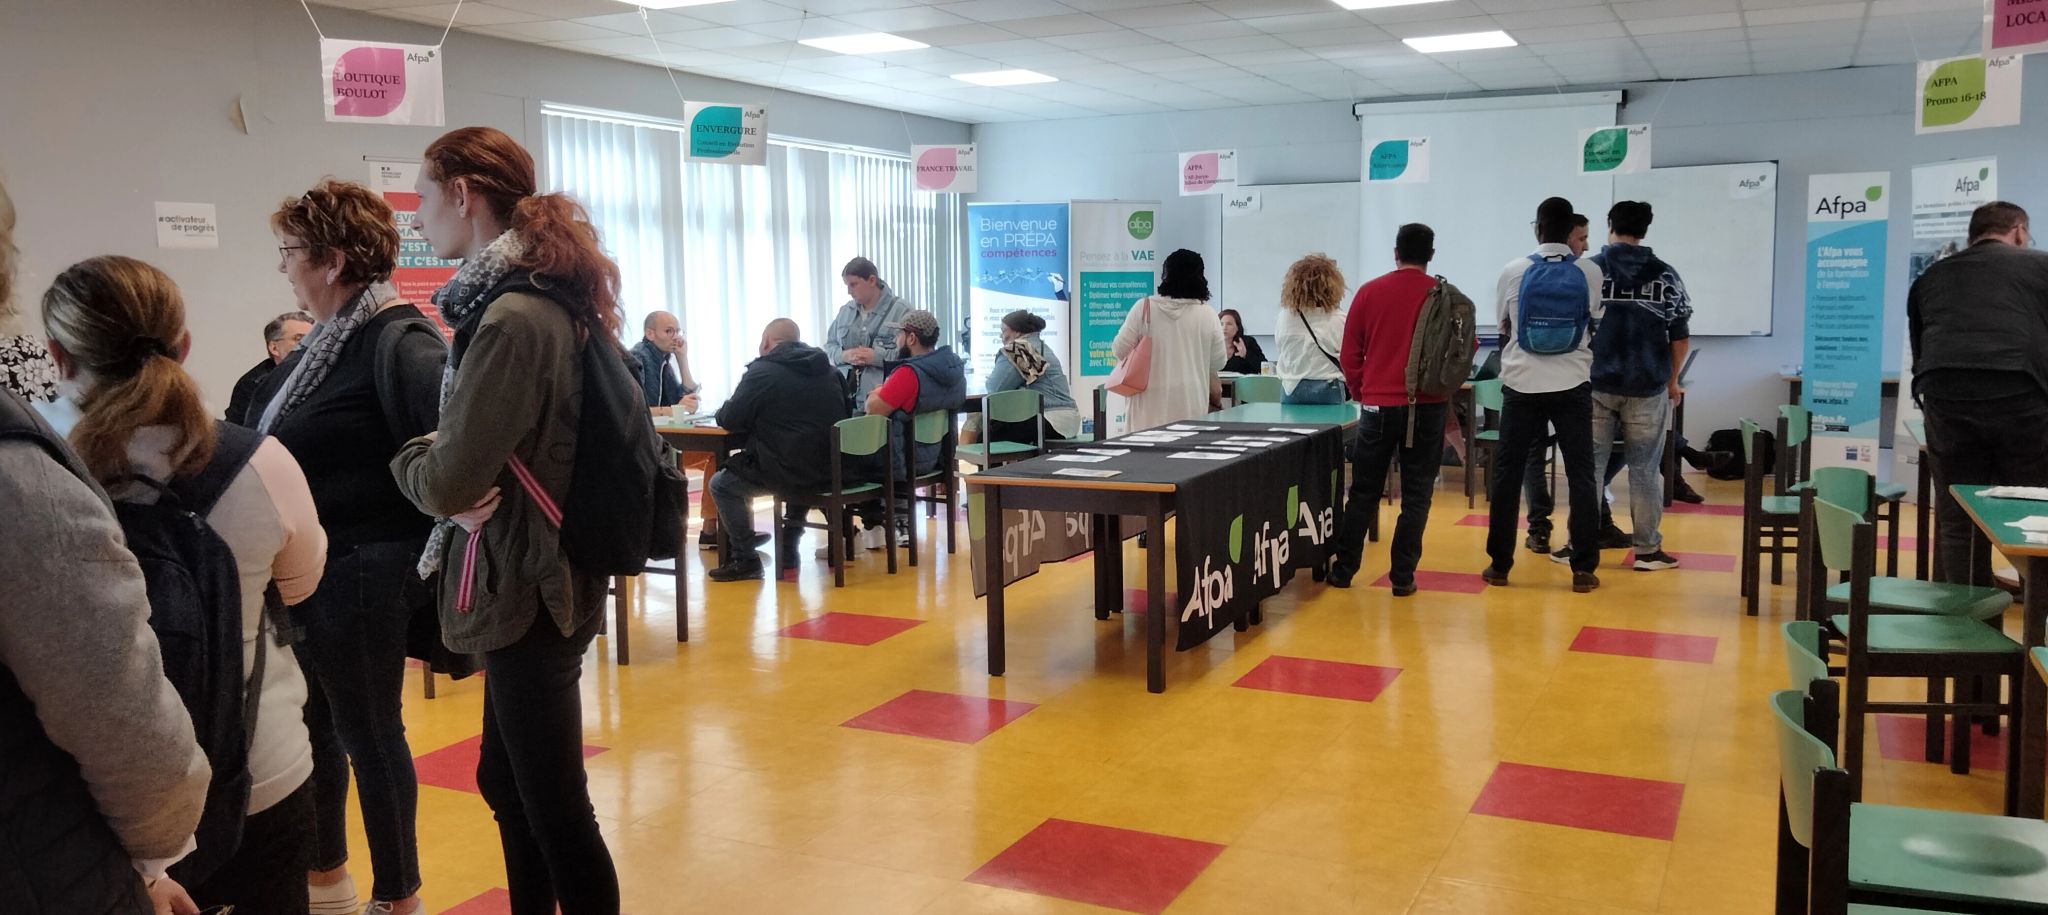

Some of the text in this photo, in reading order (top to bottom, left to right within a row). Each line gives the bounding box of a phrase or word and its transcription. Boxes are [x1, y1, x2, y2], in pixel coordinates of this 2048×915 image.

[407, 53, 429, 64] Afpa
[1989, 59, 2010, 69] Afpa
[1931, 77, 1958, 88] AFPA
[337, 88, 388, 99] BOULOT
[1926, 91, 1987, 107] Promo 16-18
[744, 111, 760, 119] Afpa
[696, 124, 757, 136] ENVERGURE
[1739, 179, 1760, 189] Afpa
[1955, 176, 1980, 196] Afpa
[1230, 200, 1248, 208] Afpa
[1815, 195, 1867, 219] Afpa
[980, 218, 1057, 232] Bienvenue
[1129, 217, 1152, 233] afpa
[981, 231, 1057, 248] en PRÉPA
[981, 249, 1057, 259] compétences
[1131, 250, 1154, 260] VAE
[1817, 246, 1863, 258] L'Afpa vous
[398, 257, 411, 266] ET
[414, 256, 443, 266] C'EST
[1817, 258, 1868, 268] accompagne
[1089, 350, 1104, 358] votre
[1253, 521, 1290, 589] Afpa
[1181, 555, 1234, 630] Afpa
